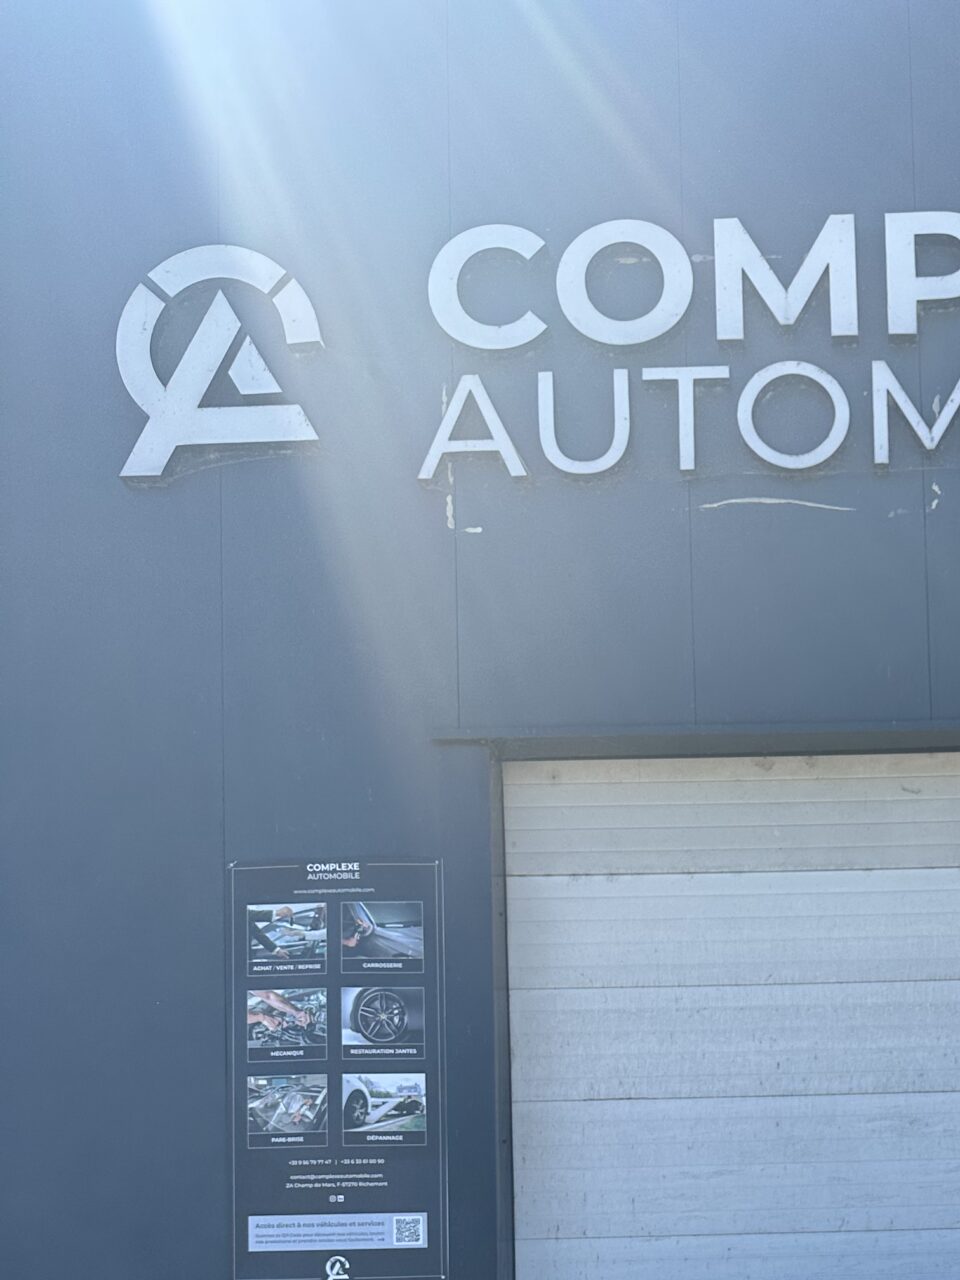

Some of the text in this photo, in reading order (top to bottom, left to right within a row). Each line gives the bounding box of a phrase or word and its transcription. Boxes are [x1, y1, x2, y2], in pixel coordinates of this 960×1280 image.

[306, 862, 360, 872] COMPLEXE
[307, 871, 360, 880] AUTOMOBILE
[276, 963, 294, 971] VENTE
